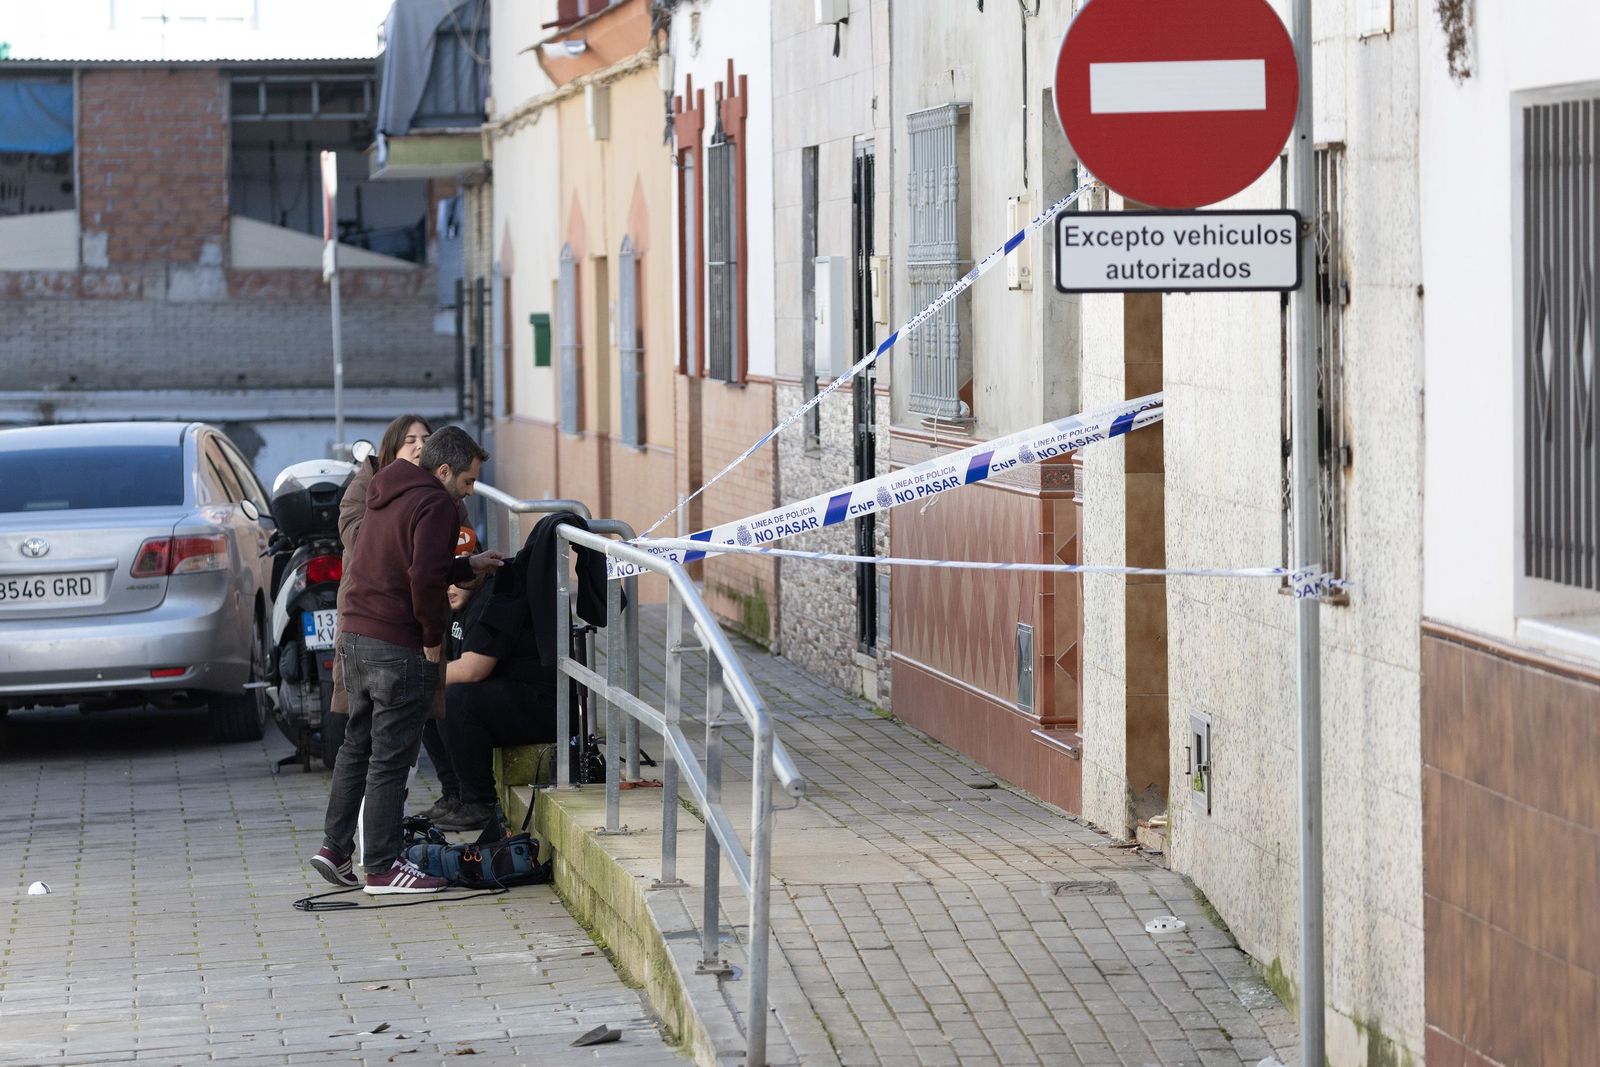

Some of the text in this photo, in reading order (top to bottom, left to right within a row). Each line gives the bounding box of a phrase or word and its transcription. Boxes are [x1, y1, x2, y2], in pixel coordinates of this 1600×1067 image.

[1065, 223, 1293, 251] Excepto vehiculos
[1106, 258, 1251, 280] autorizados
[1033, 424, 1100, 449] LINEA DE POLICIA
[1037, 432, 1105, 460] NO PASAR
[991, 458, 1017, 473] CNP
[890, 465, 957, 491] LINEA DE POLICIA
[894, 475, 962, 504] NO PASAR
[751, 506, 816, 530] LINEA DE POLICIA
[849, 500, 875, 514] CNP
[754, 529, 774, 544] NO
[776, 516, 819, 538] PASAR
[617, 563, 635, 577] NO
[53, 577, 92, 597] GRD
[317, 613, 337, 627] 13
